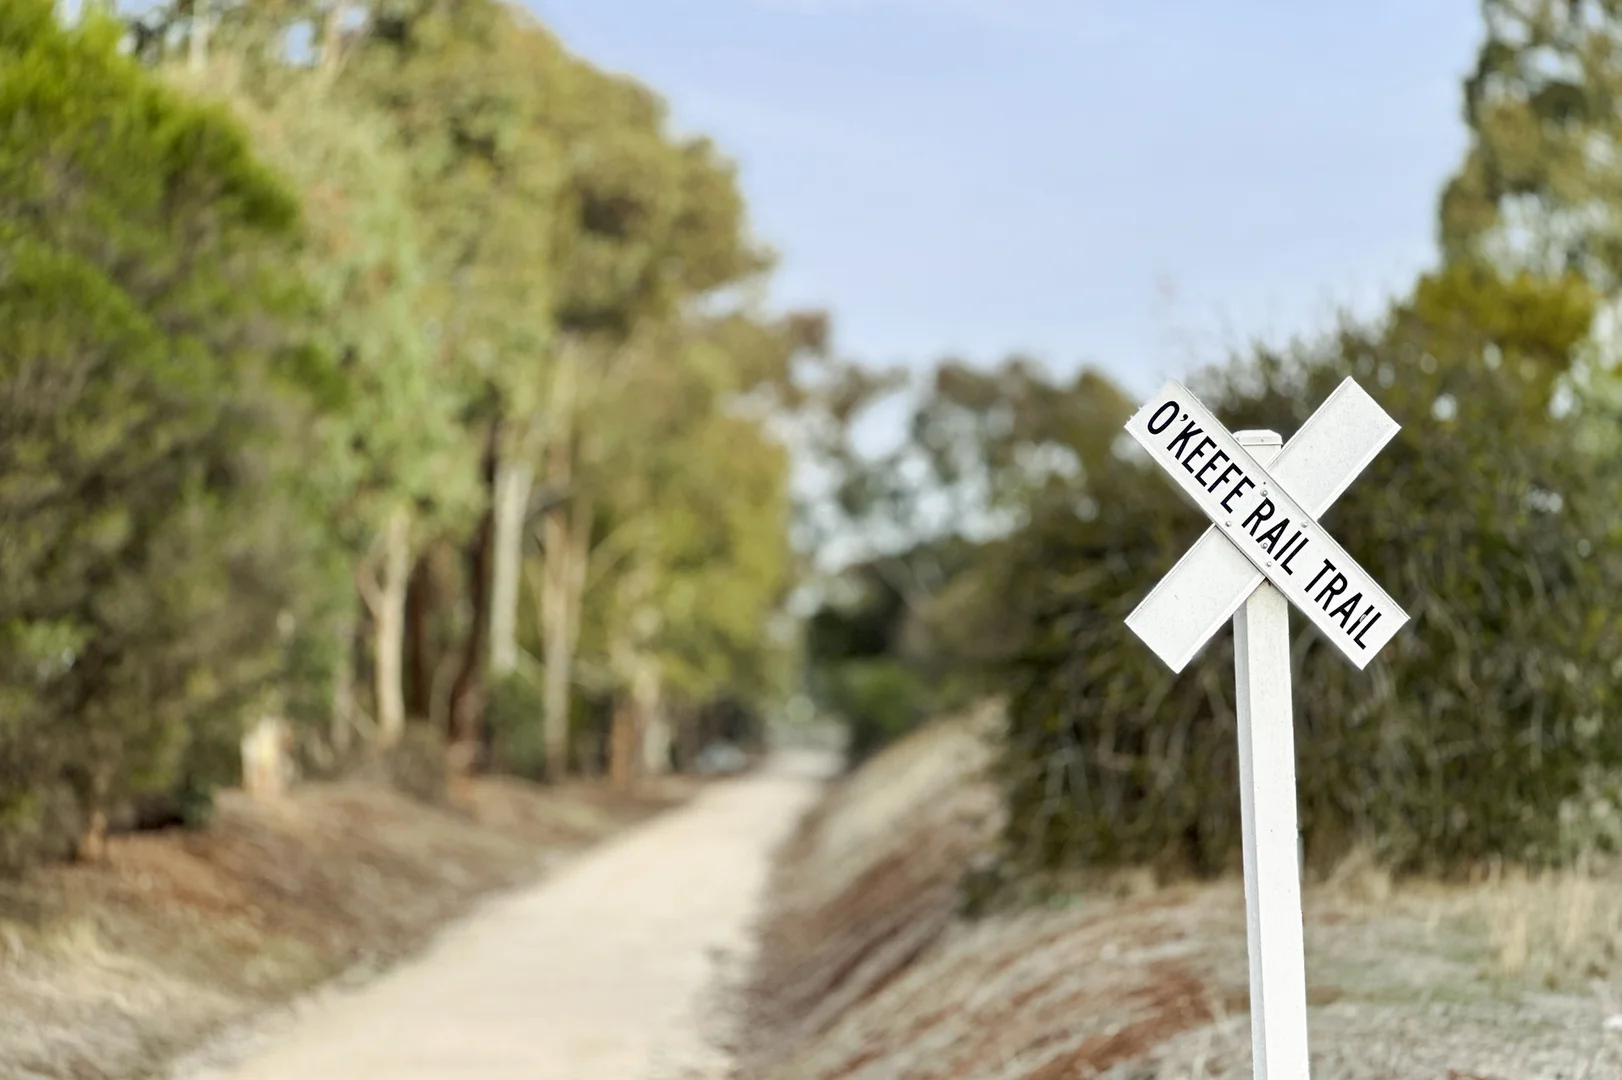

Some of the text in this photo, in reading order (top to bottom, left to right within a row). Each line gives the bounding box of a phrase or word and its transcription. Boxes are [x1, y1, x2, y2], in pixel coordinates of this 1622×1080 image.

[1147, 400, 1382, 650] O'KEEFE RAIL TRAIL
